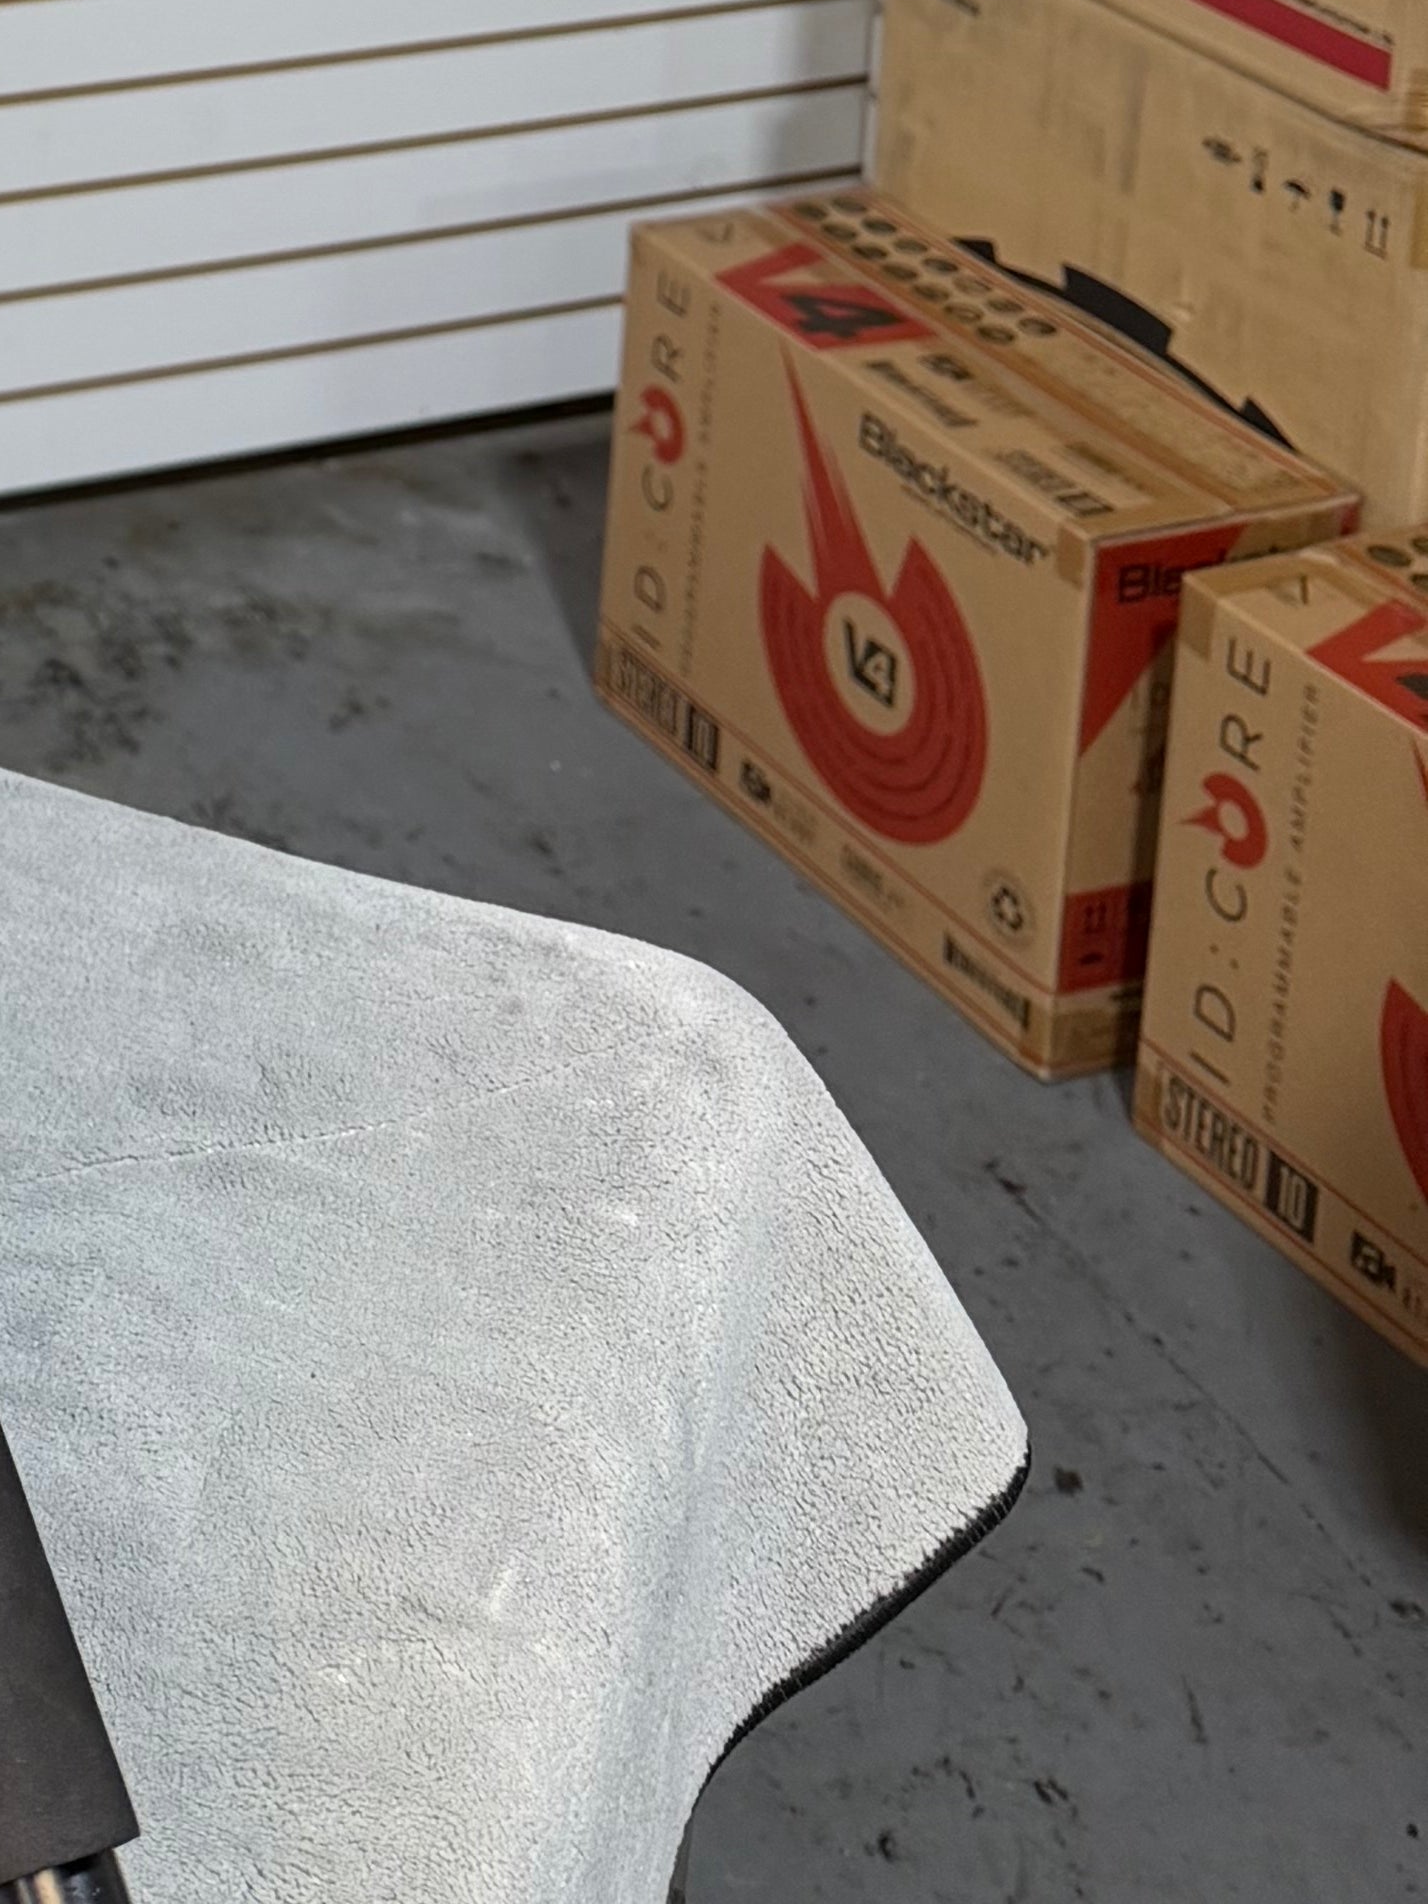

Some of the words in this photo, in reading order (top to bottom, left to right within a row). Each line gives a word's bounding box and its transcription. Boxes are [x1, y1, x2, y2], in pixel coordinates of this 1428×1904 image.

[857, 409, 1051, 567] Blackstar
[1160, 1066, 1260, 1192] STEREO
[1272, 1155, 1314, 1239] 10
